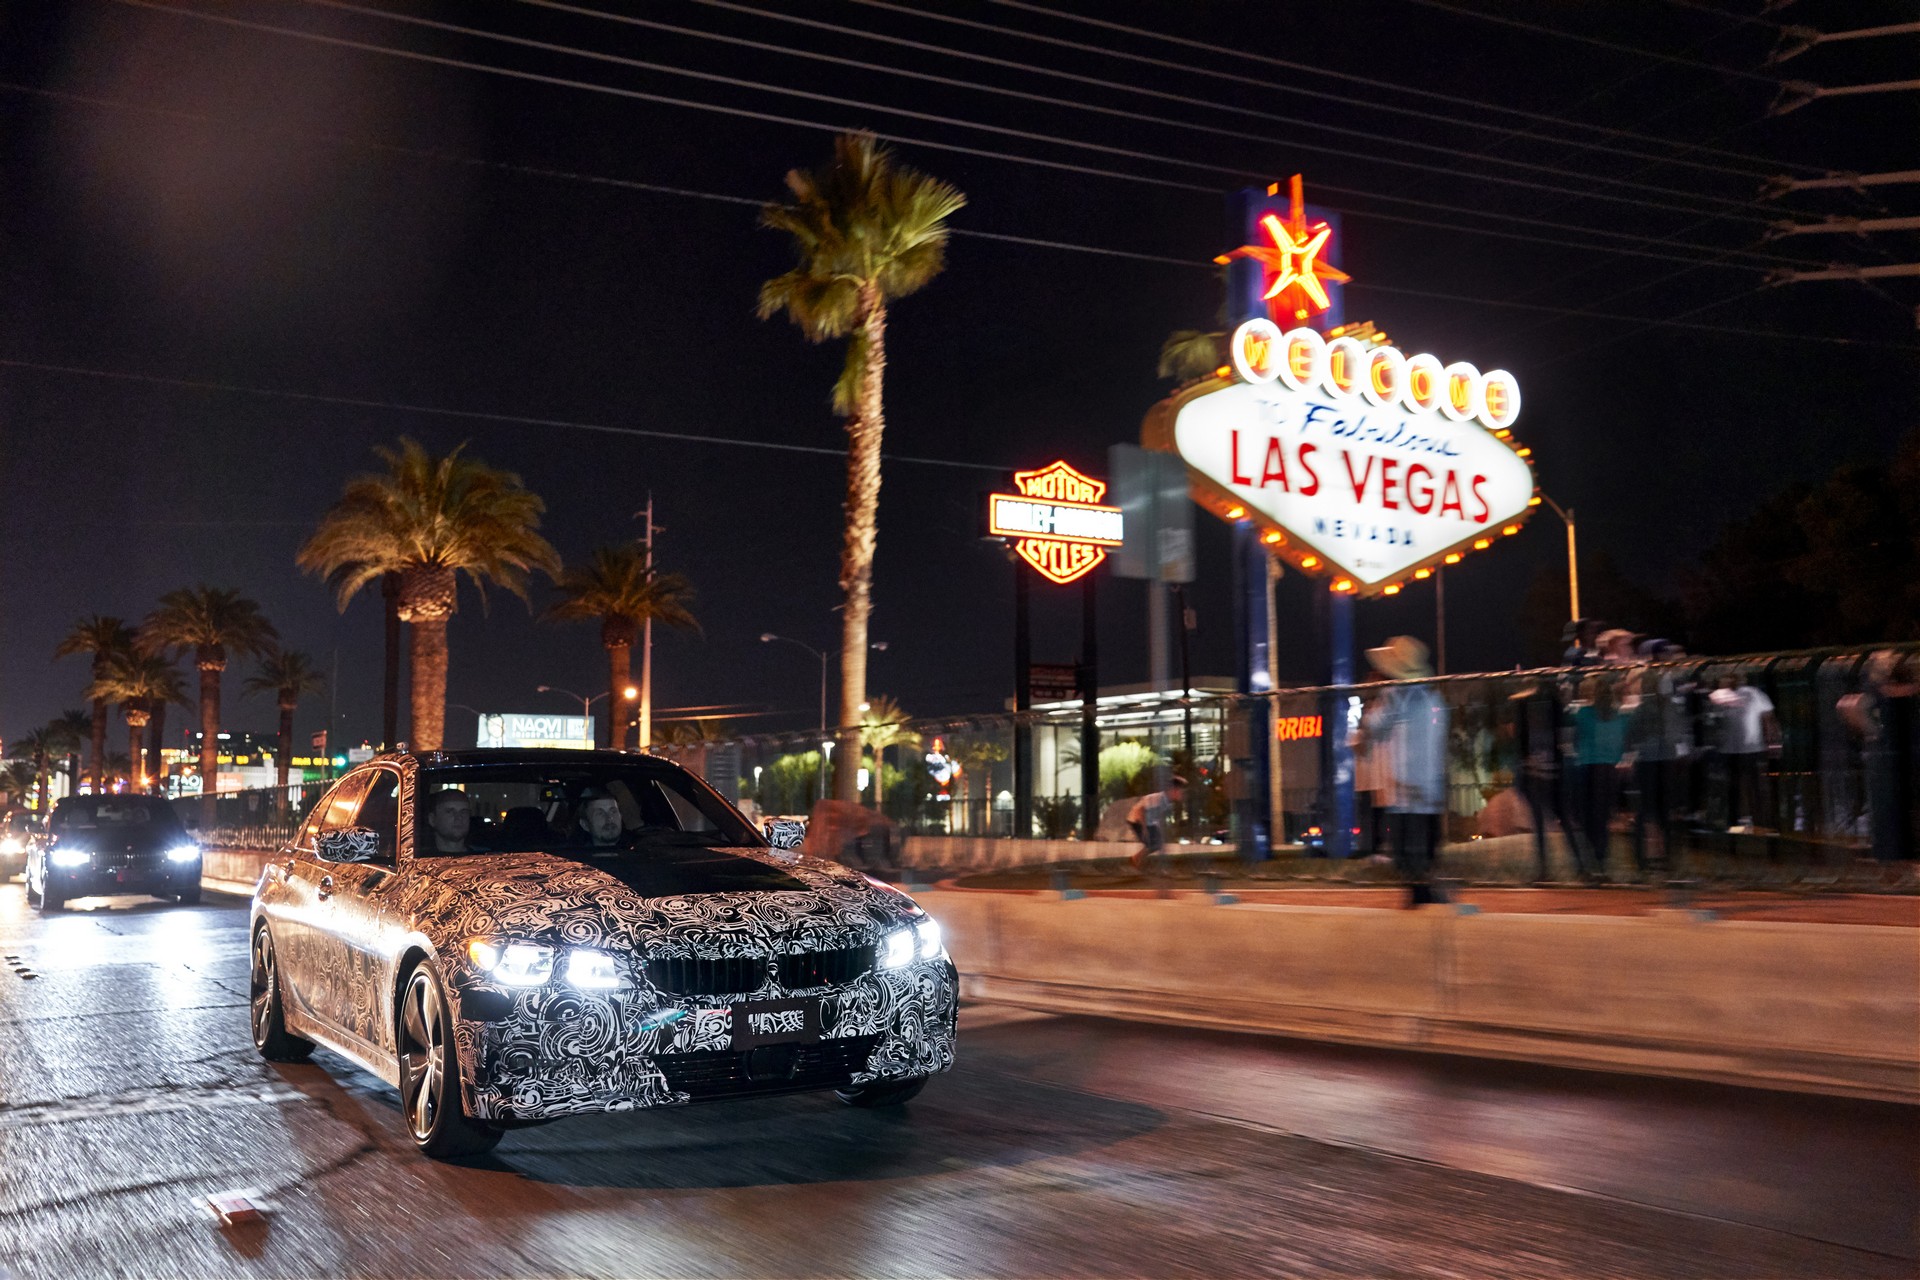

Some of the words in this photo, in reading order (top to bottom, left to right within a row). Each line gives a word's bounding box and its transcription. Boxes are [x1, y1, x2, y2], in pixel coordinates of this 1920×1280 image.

[1243, 332, 1508, 417] WELCOME
[1026, 470, 1096, 503] MOTOR
[1231, 429, 1320, 497] LAS
[1341, 449, 1490, 525] VEGAS
[1312, 516, 1417, 548] NEVADA
[1026, 539, 1095, 567] CYCLES
